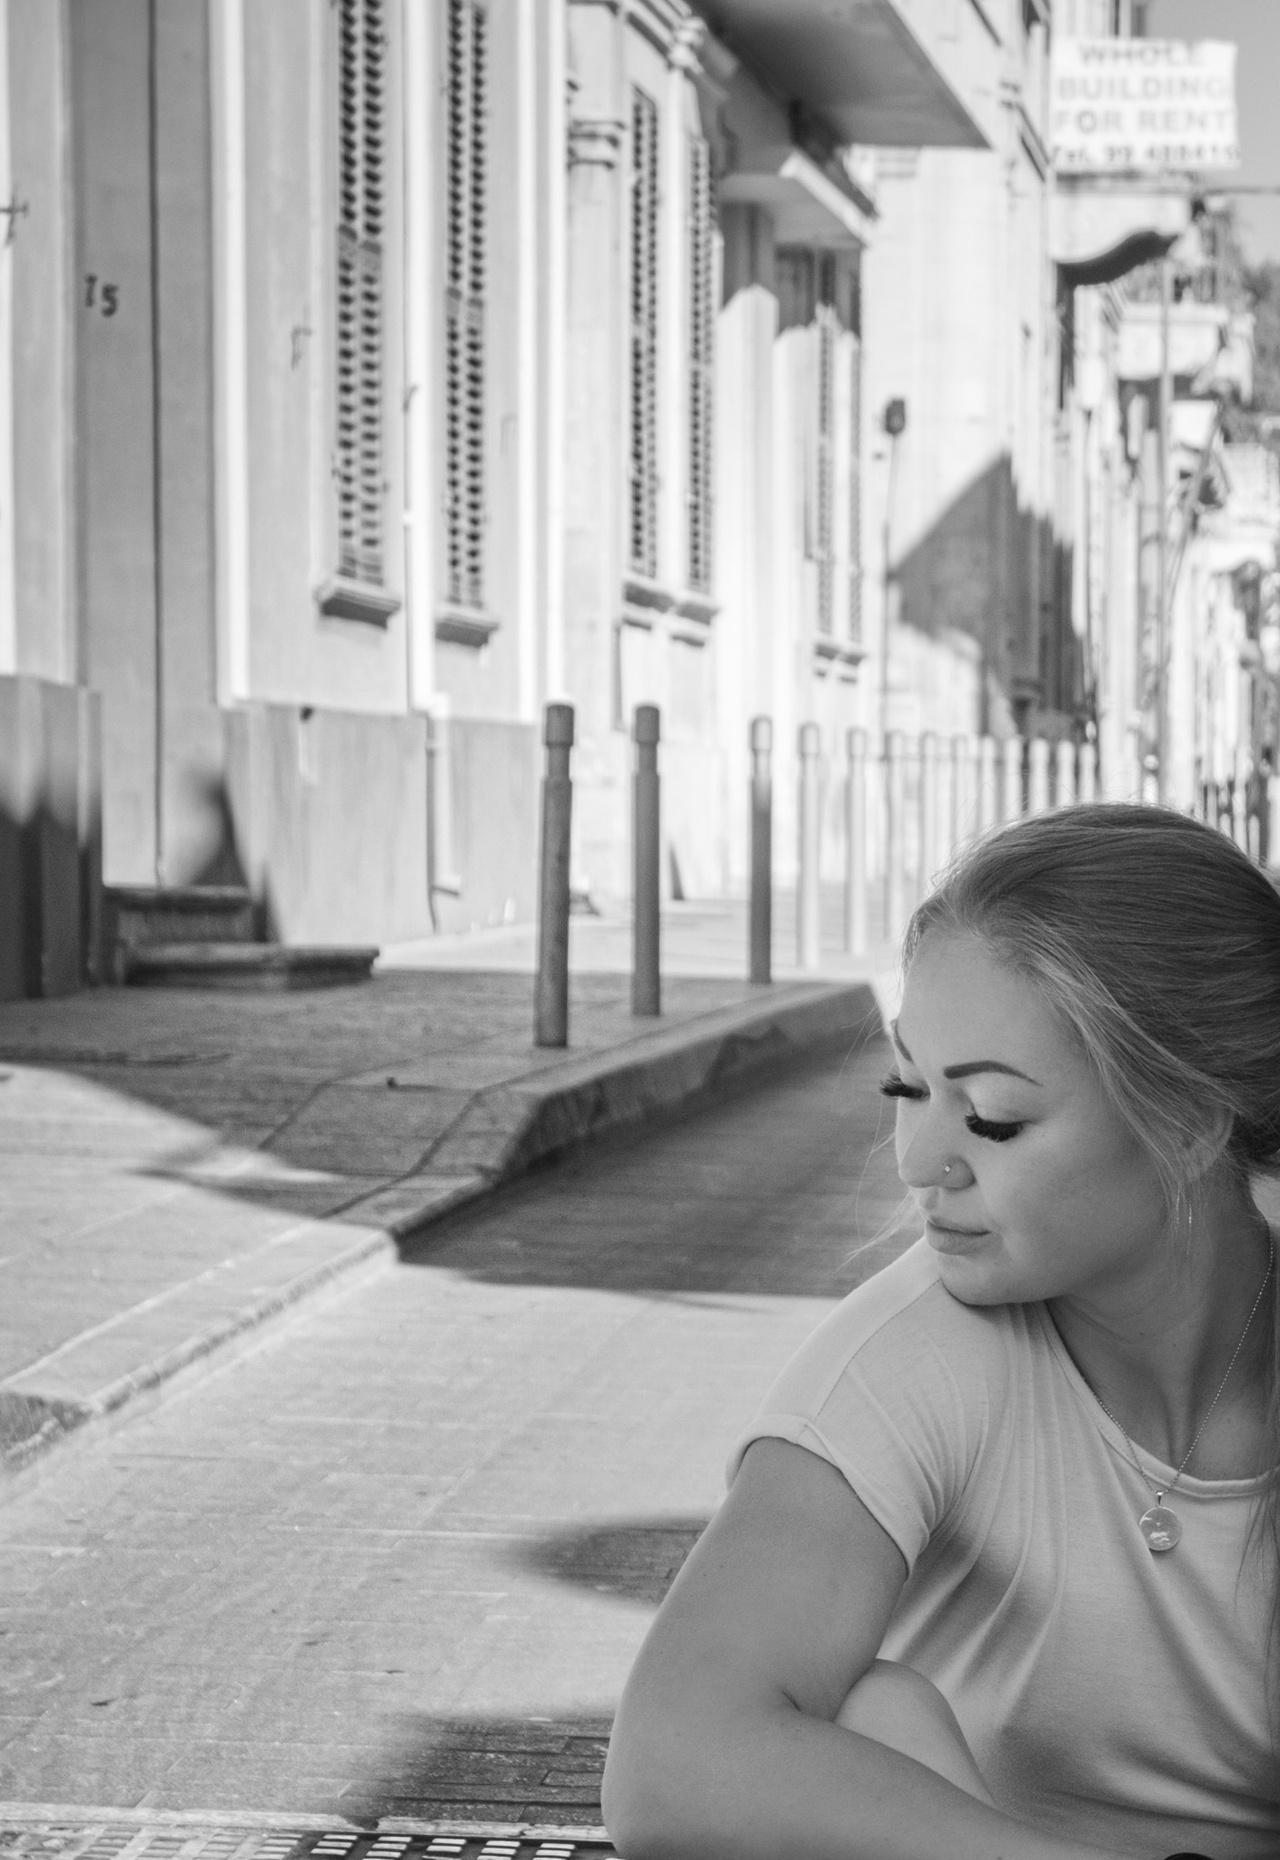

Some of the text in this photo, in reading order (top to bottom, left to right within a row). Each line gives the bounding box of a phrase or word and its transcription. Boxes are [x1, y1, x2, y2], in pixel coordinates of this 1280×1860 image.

[1078, 43, 1204, 66] WHOLE
[1058, 77, 1231, 99] BUILDING
[1055, 109, 1228, 133] FOR RENT
[84, 273, 119, 318] 15
